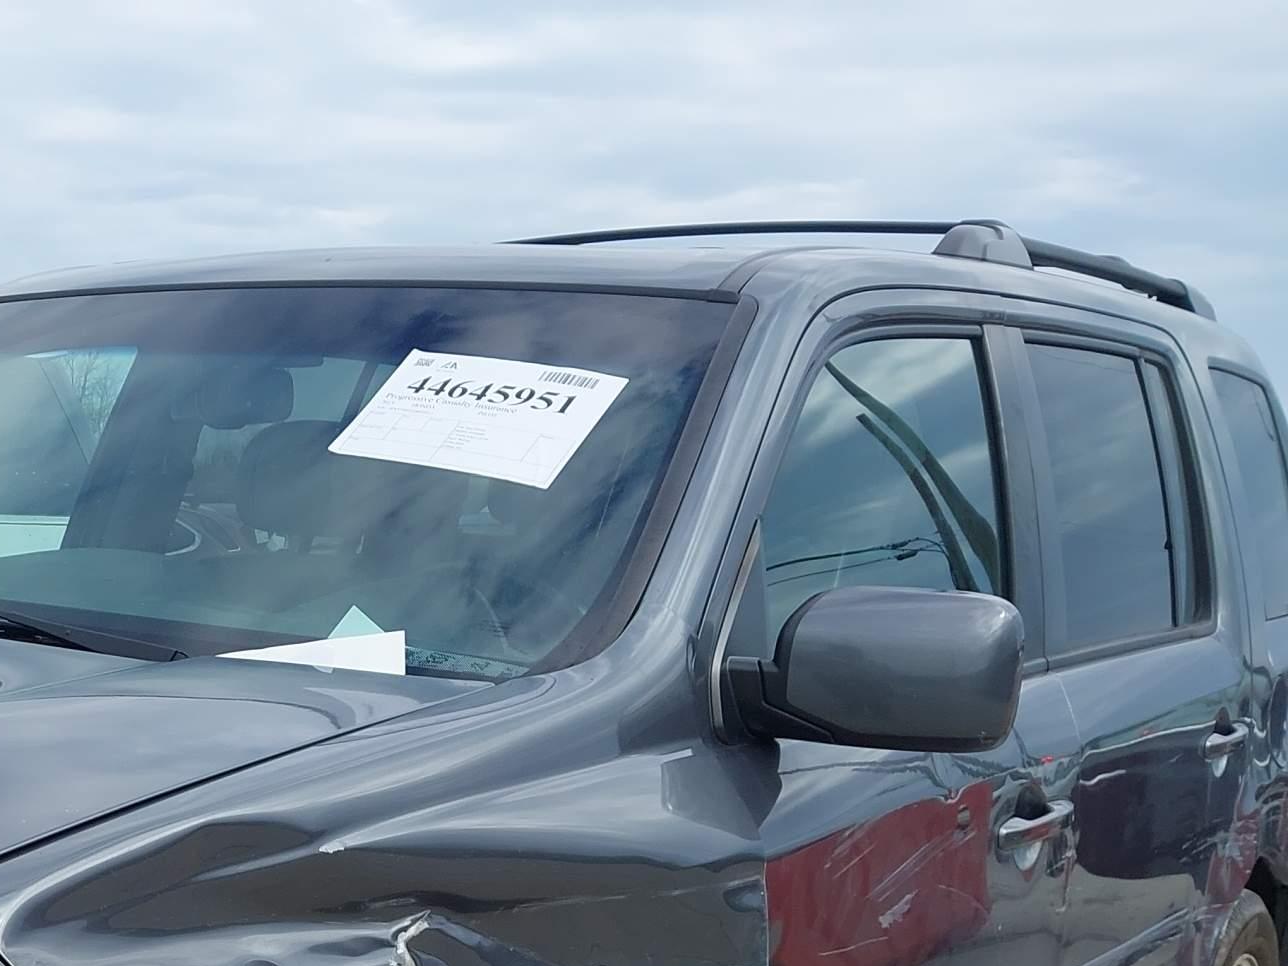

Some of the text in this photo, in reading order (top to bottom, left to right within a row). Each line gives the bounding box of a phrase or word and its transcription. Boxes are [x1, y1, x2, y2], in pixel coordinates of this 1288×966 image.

[385, 392, 435, 404] Progressive
[474, 401, 518, 414] Insurance
[407, 375, 578, 415] 44645951
